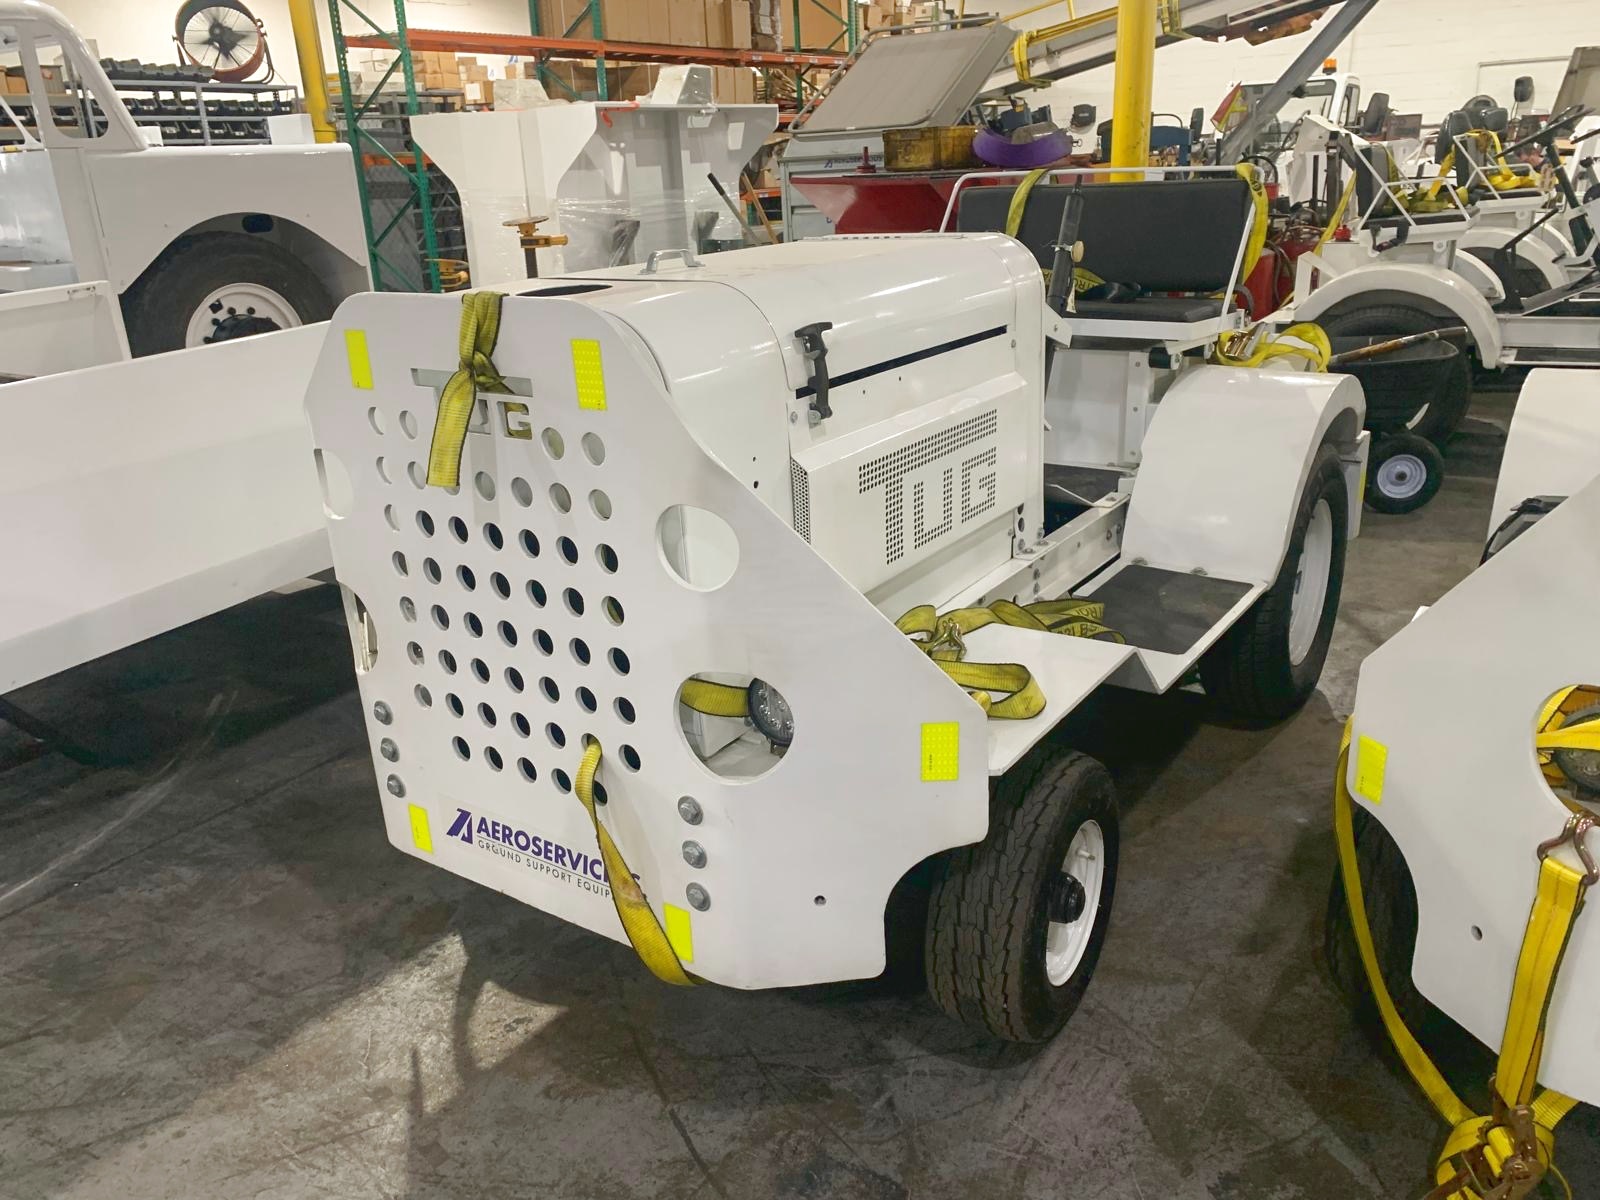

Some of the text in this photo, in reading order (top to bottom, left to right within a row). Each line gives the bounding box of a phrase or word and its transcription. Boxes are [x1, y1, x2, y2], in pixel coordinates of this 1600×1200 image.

[859, 409, 997, 565] TUG
[477, 816, 640, 883] AEROSERVIC
[478, 839, 521, 864] GROUND
[526, 857, 573, 885] SUPPORT
